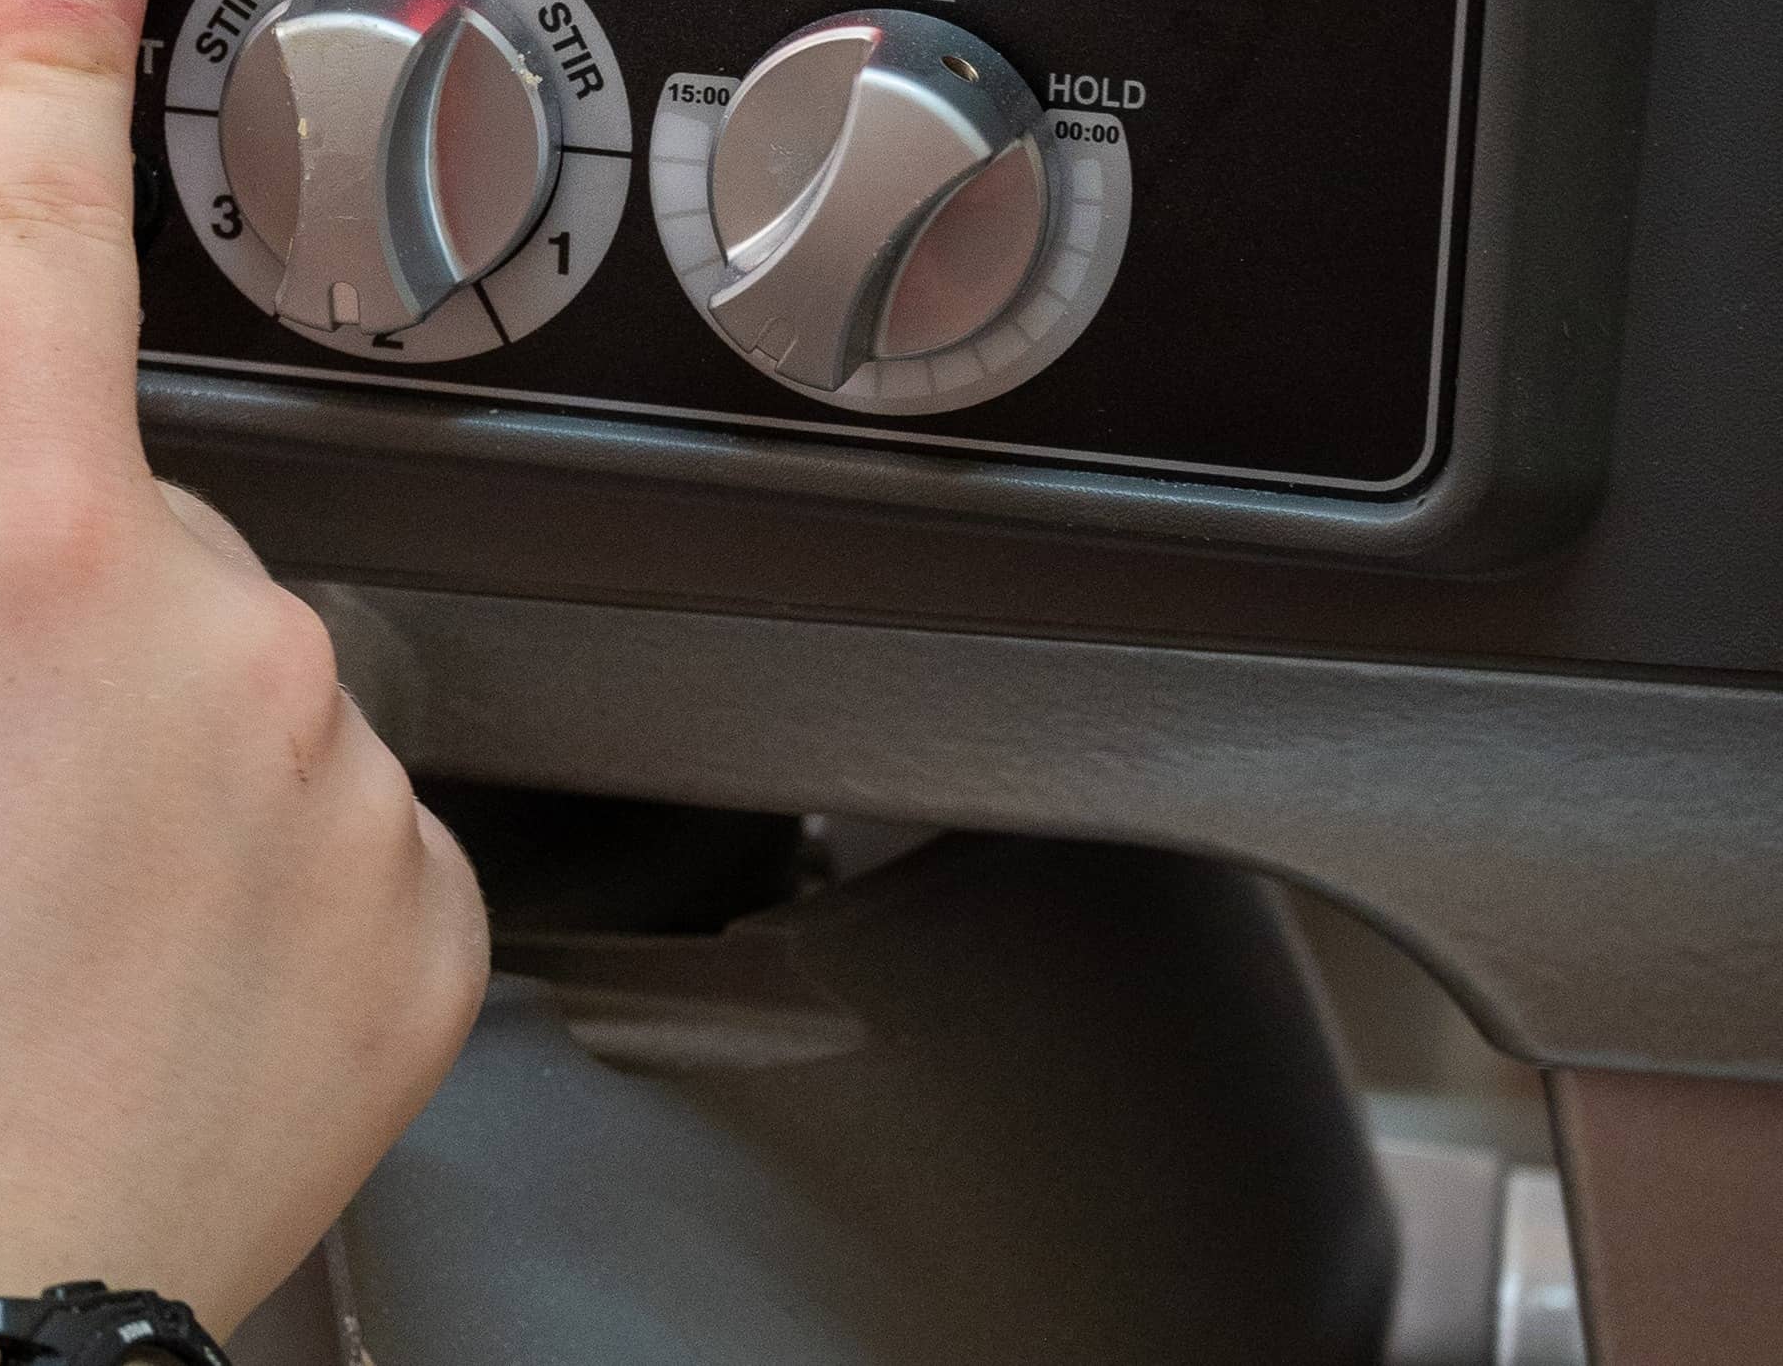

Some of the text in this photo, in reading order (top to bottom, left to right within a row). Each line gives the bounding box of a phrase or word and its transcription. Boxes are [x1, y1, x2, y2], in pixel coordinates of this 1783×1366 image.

[538, 0, 605, 101] STIR
[668, 83, 730, 107] 15:00
[1047, 73, 1147, 111] HOLD
[1054, 120, 1121, 146] 00:00
[211, 194, 244, 241] 3
[548, 231, 570, 274] 1
